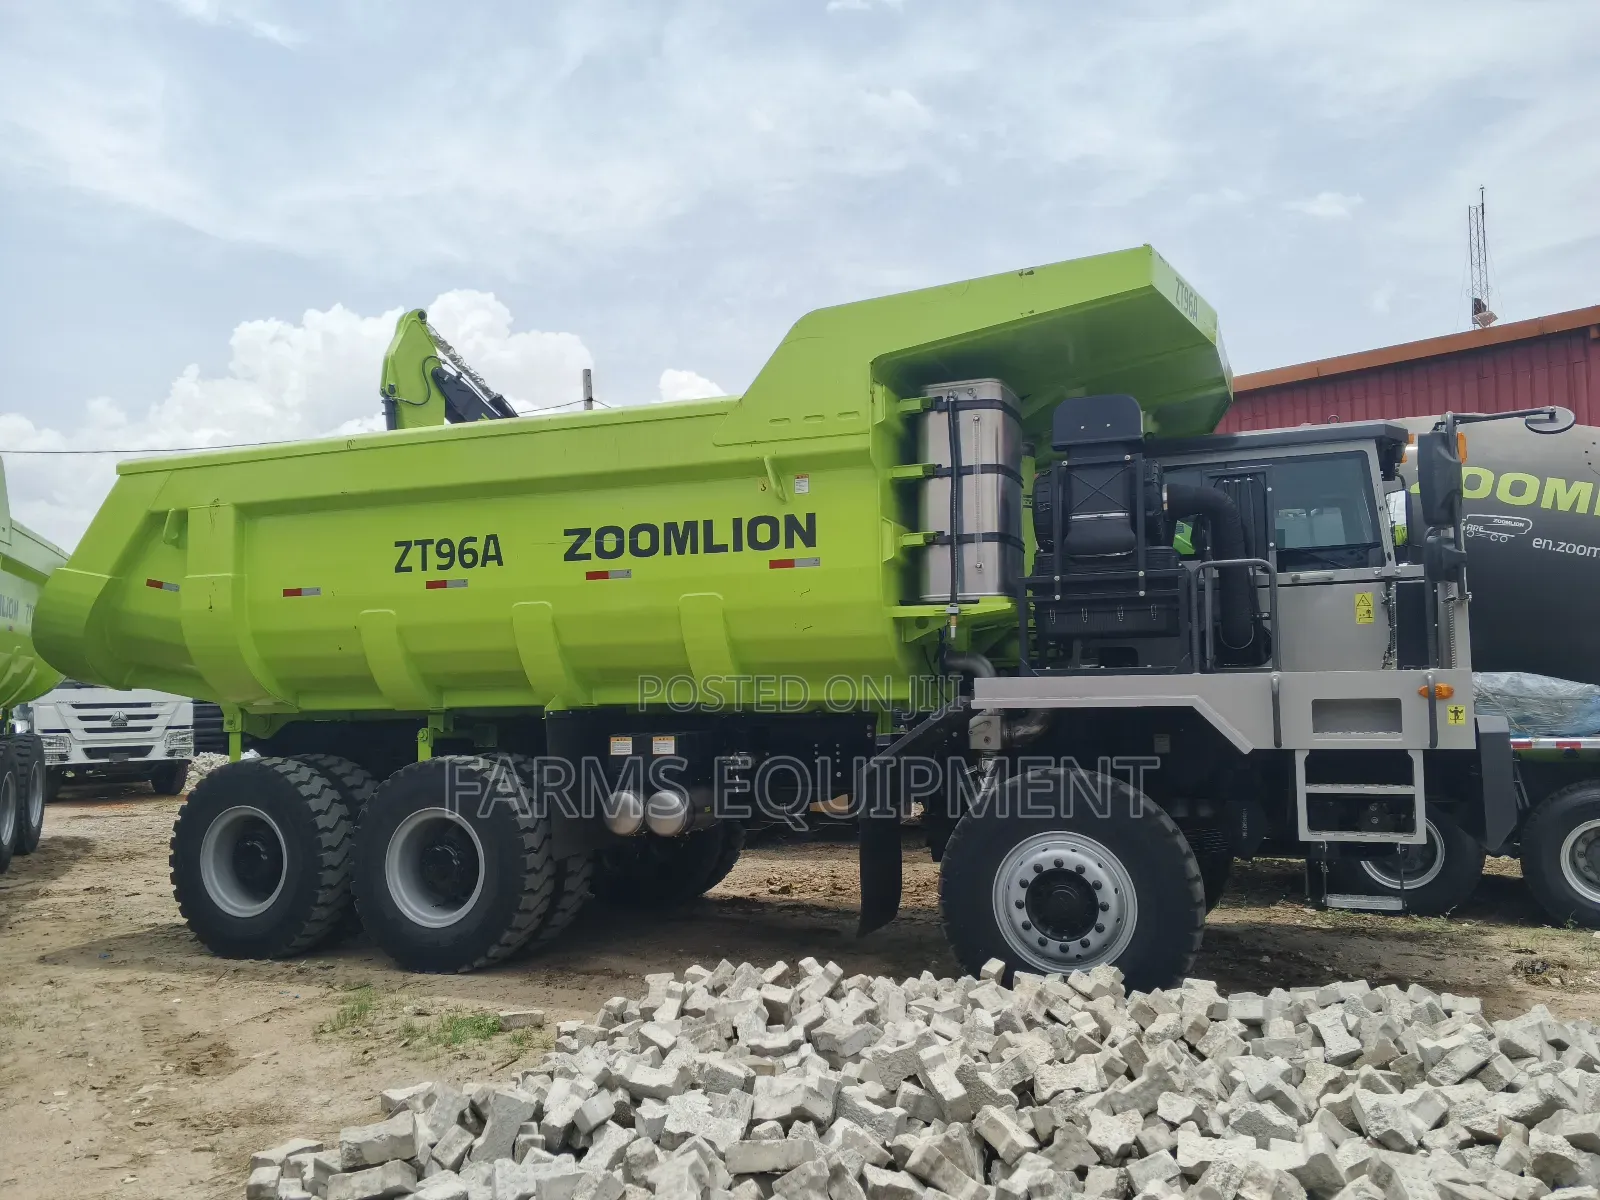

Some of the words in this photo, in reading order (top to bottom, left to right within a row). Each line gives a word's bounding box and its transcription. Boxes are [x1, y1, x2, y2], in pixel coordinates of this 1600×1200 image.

[1175, 276, 1198, 323] ZT96A
[1410, 466, 1600, 516] OOM
[394, 534, 504, 573] ZT96A
[563, 512, 817, 561] ZOOMLION
